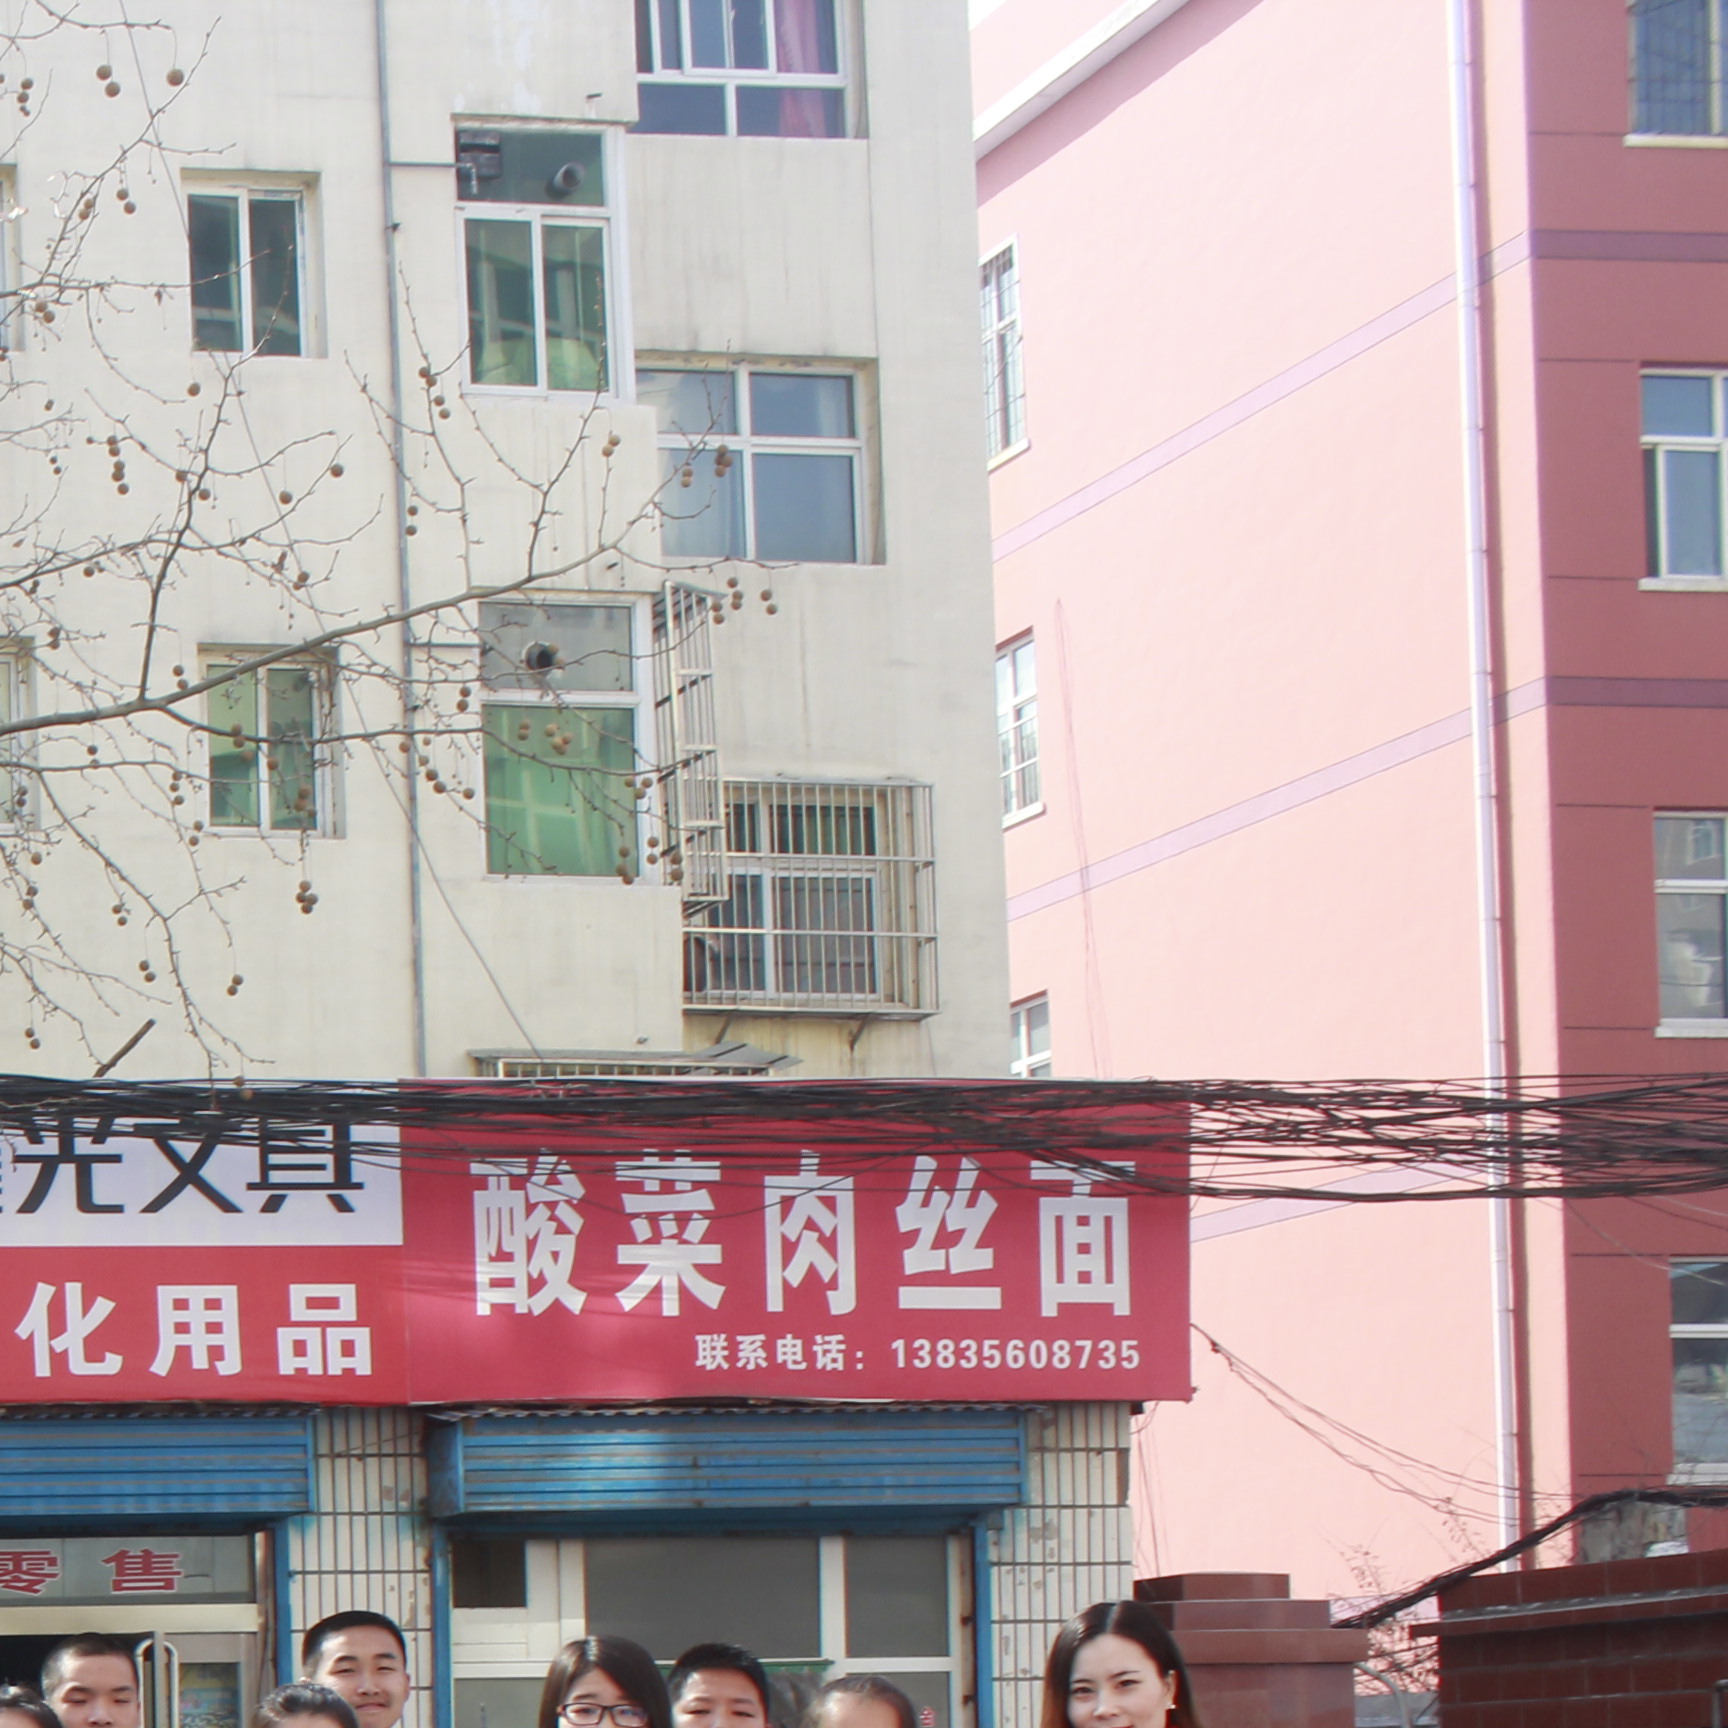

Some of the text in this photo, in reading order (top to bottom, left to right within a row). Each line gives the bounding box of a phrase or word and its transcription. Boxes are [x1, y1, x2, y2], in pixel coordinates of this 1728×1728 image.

[469, 1147, 1139, 1319] 酸菜肉丝面
